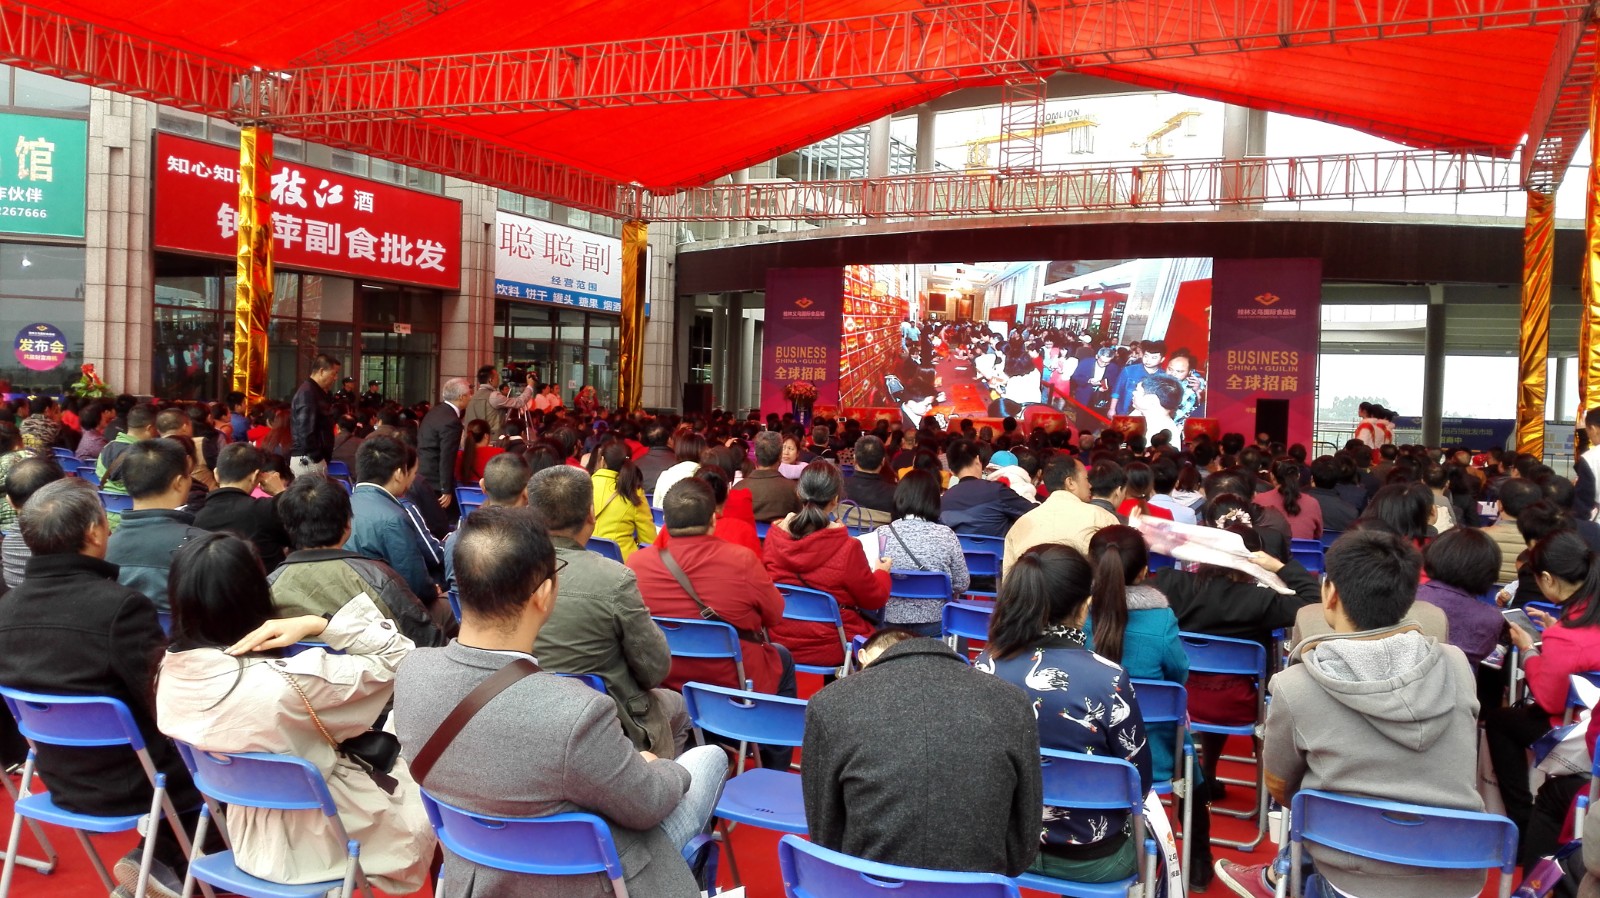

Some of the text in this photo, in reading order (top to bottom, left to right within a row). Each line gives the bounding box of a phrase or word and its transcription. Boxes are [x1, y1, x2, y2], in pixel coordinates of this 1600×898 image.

[0, 206, 47, 218] 267666
[499, 222, 622, 276] 聪聪副
[551, 275, 598, 292] 经营范围
[496, 283, 520, 298] 饮料
[525, 287, 548, 301] 饼干
[19, 338, 65, 354] 发布会
[776, 347, 827, 358] BUSINESS
[1227, 351, 1299, 365] BUSINESS
[775, 366, 827, 381] 全球招商
[1226, 374, 1298, 392] 全球招商
